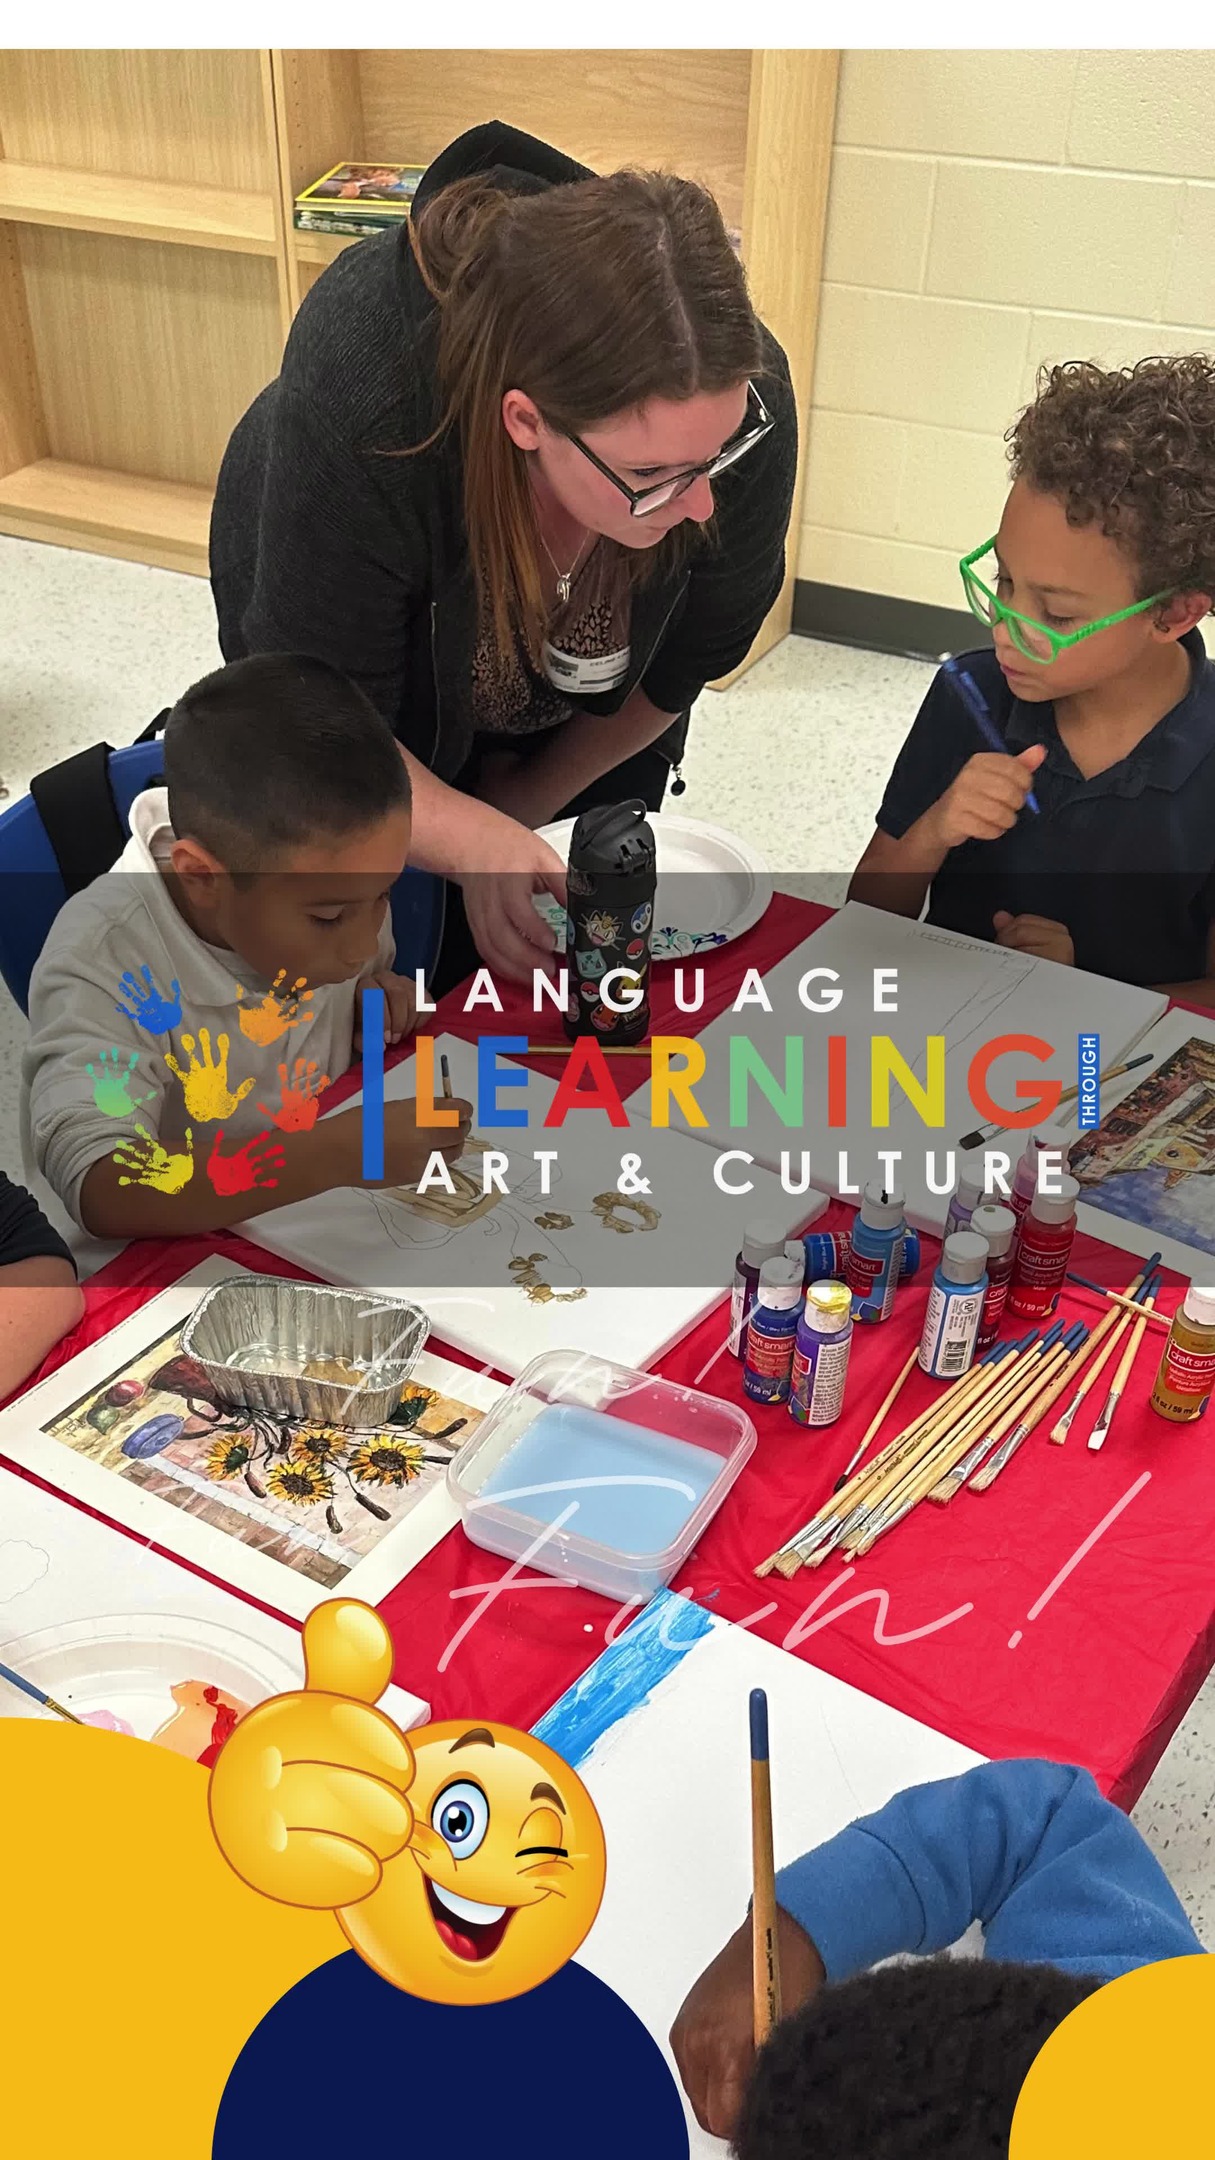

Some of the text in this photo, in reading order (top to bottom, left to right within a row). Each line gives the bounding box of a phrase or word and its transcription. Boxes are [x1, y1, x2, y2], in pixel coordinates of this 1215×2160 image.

[1021, 1251, 1042, 1265] craft
[1170, 1350, 1215, 1369] craft sma
[1173, 1405, 1182, 1414] 59
